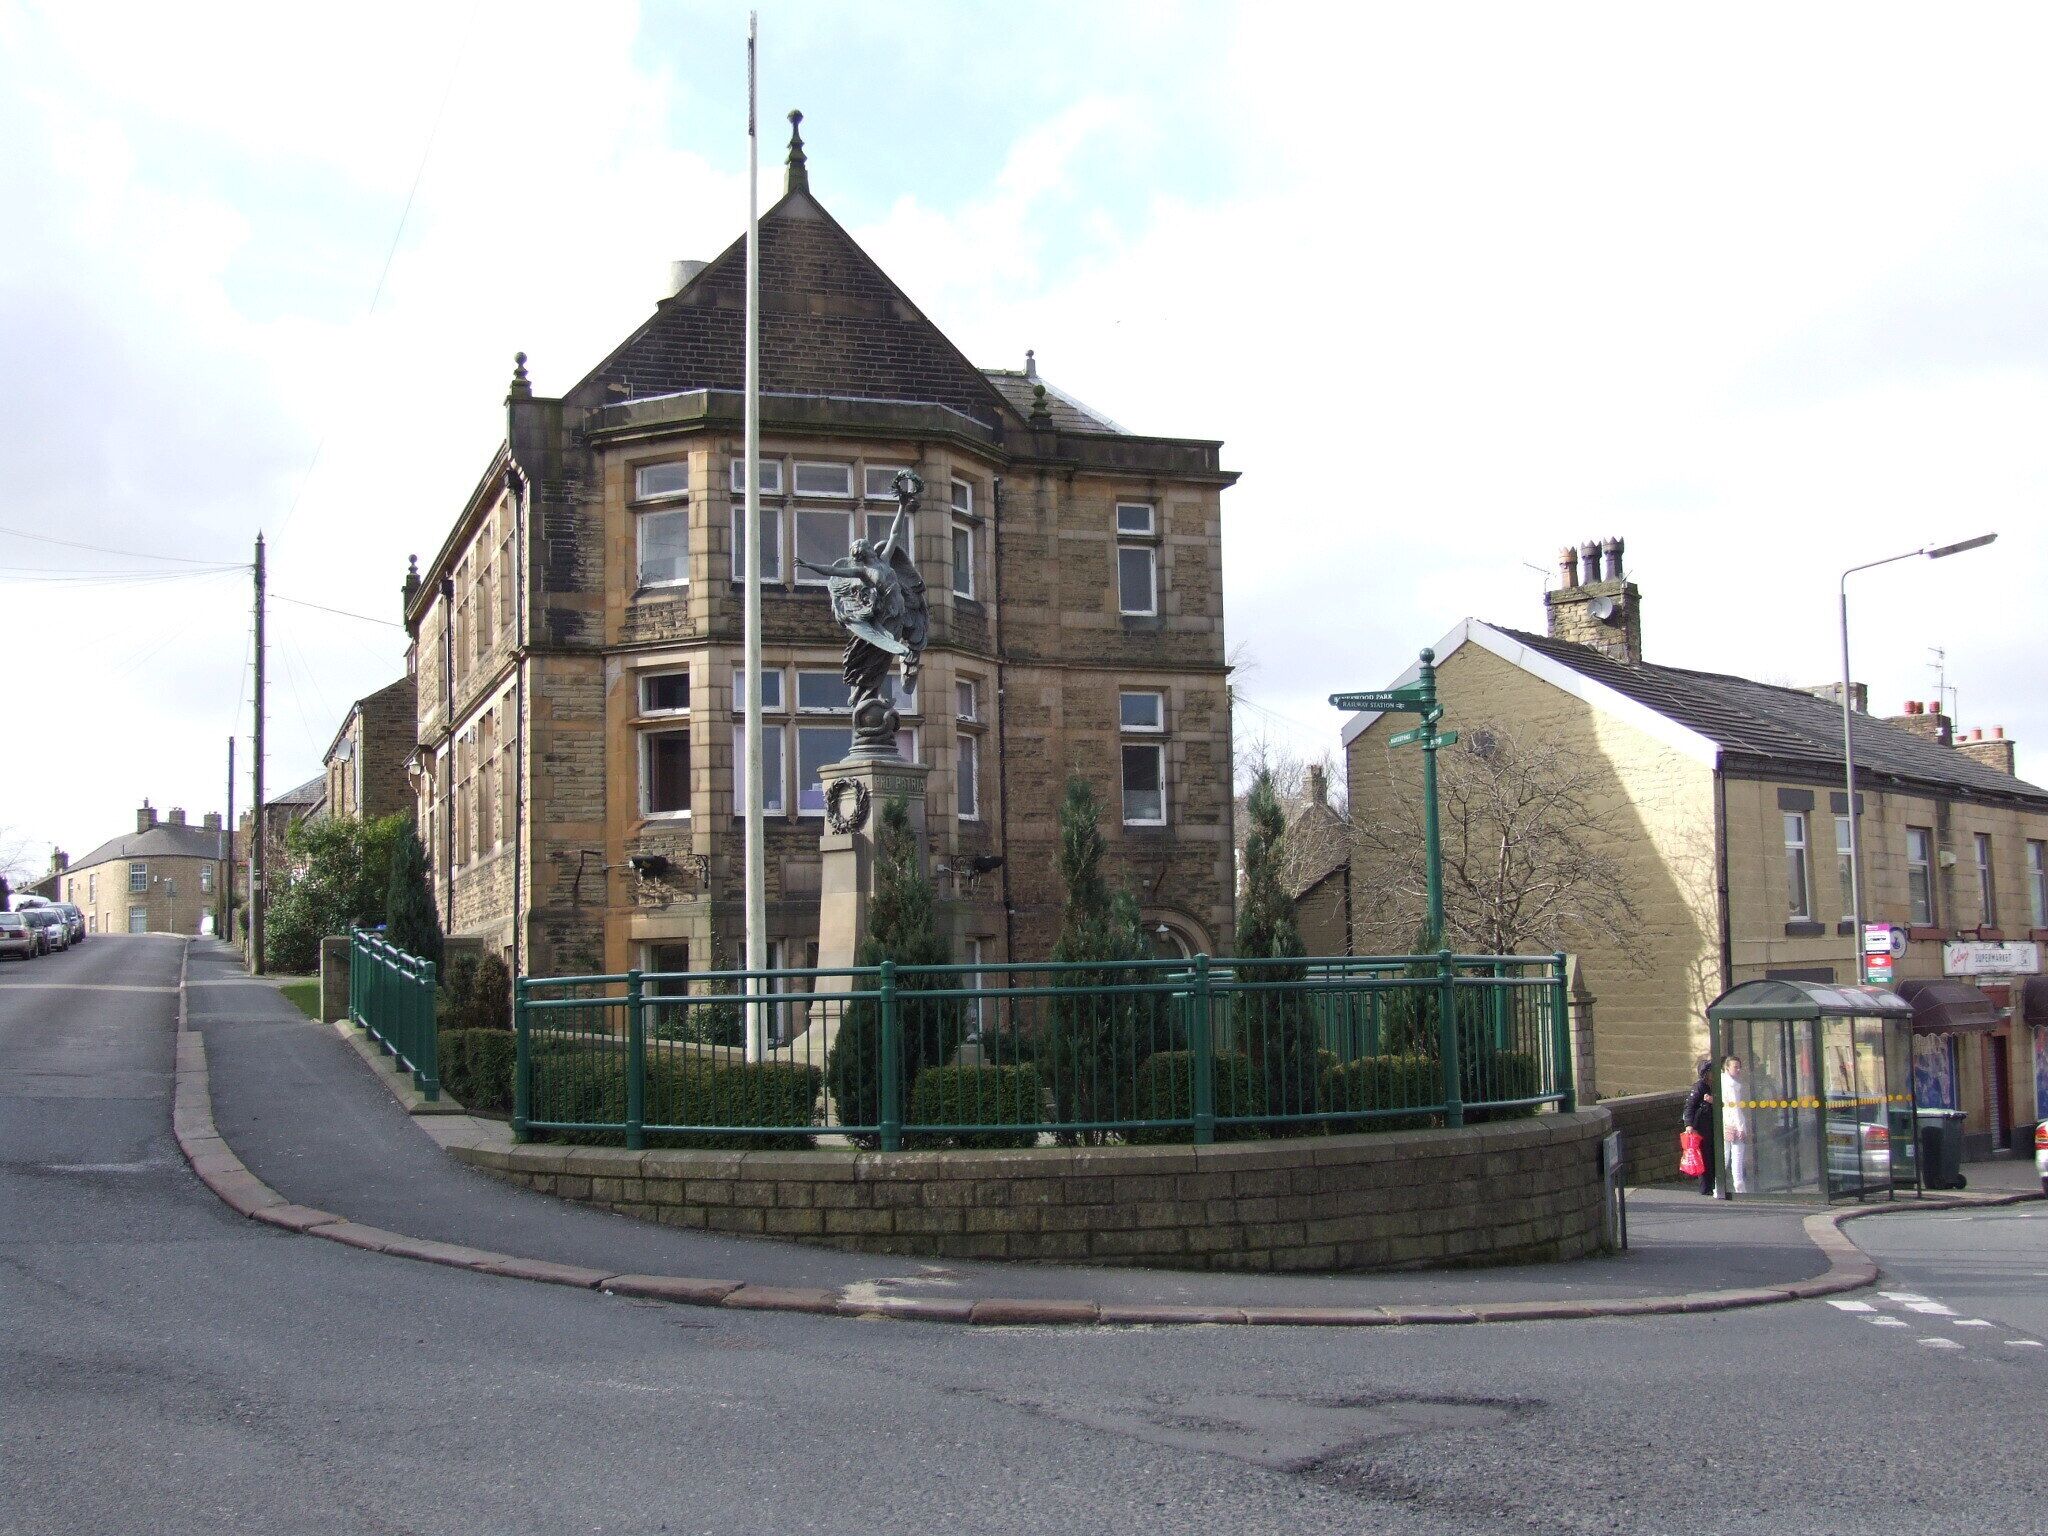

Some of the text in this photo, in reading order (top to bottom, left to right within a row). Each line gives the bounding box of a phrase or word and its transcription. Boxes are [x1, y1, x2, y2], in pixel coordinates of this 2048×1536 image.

[1370, 701, 1395, 709] STATION
[875, 775, 924, 791] PRO PATRIA
[1974, 953, 2012, 963] SUPERMARKET
